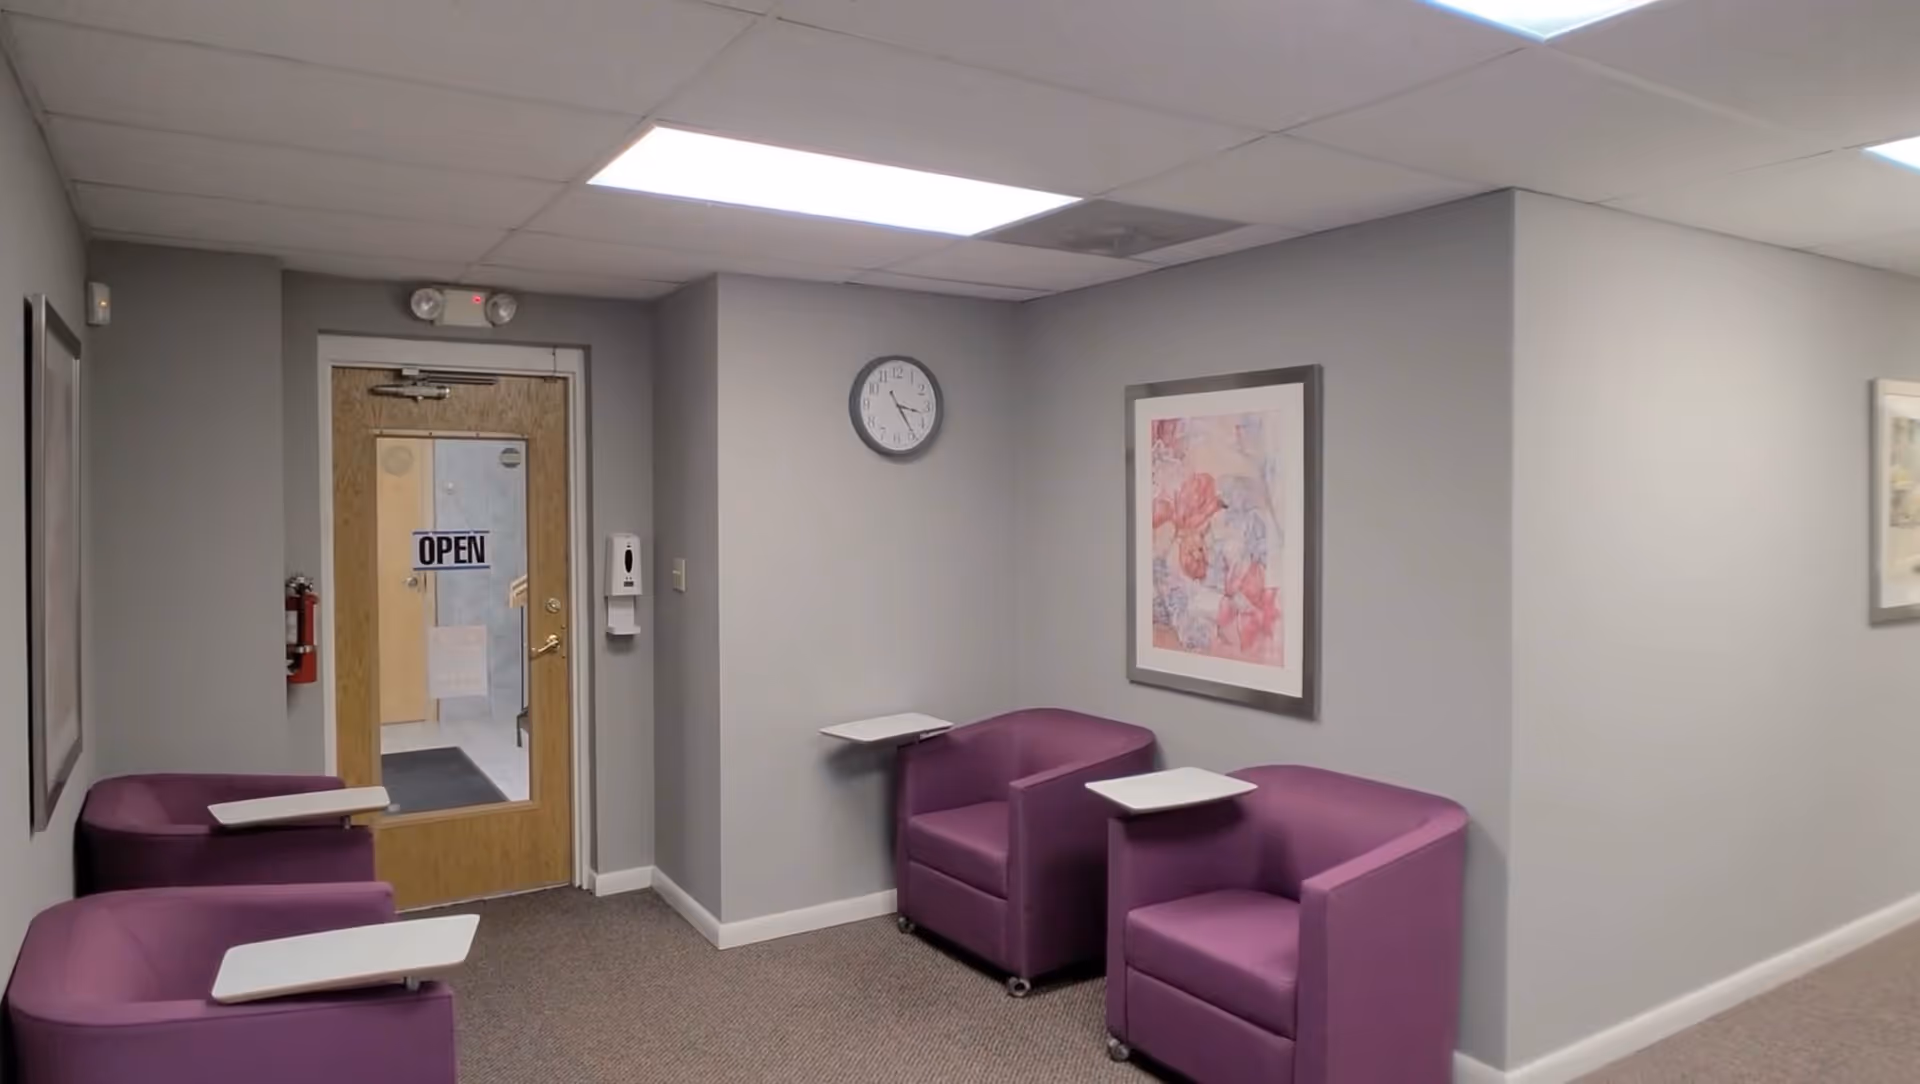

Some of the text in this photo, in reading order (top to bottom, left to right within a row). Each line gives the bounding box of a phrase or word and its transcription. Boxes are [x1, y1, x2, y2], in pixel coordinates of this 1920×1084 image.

[879, 369, 888, 383] 11
[892, 367, 903, 379] 12
[869, 383, 879, 395] 10
[917, 384, 925, 396] 2
[419, 535, 485, 566] OPEN
